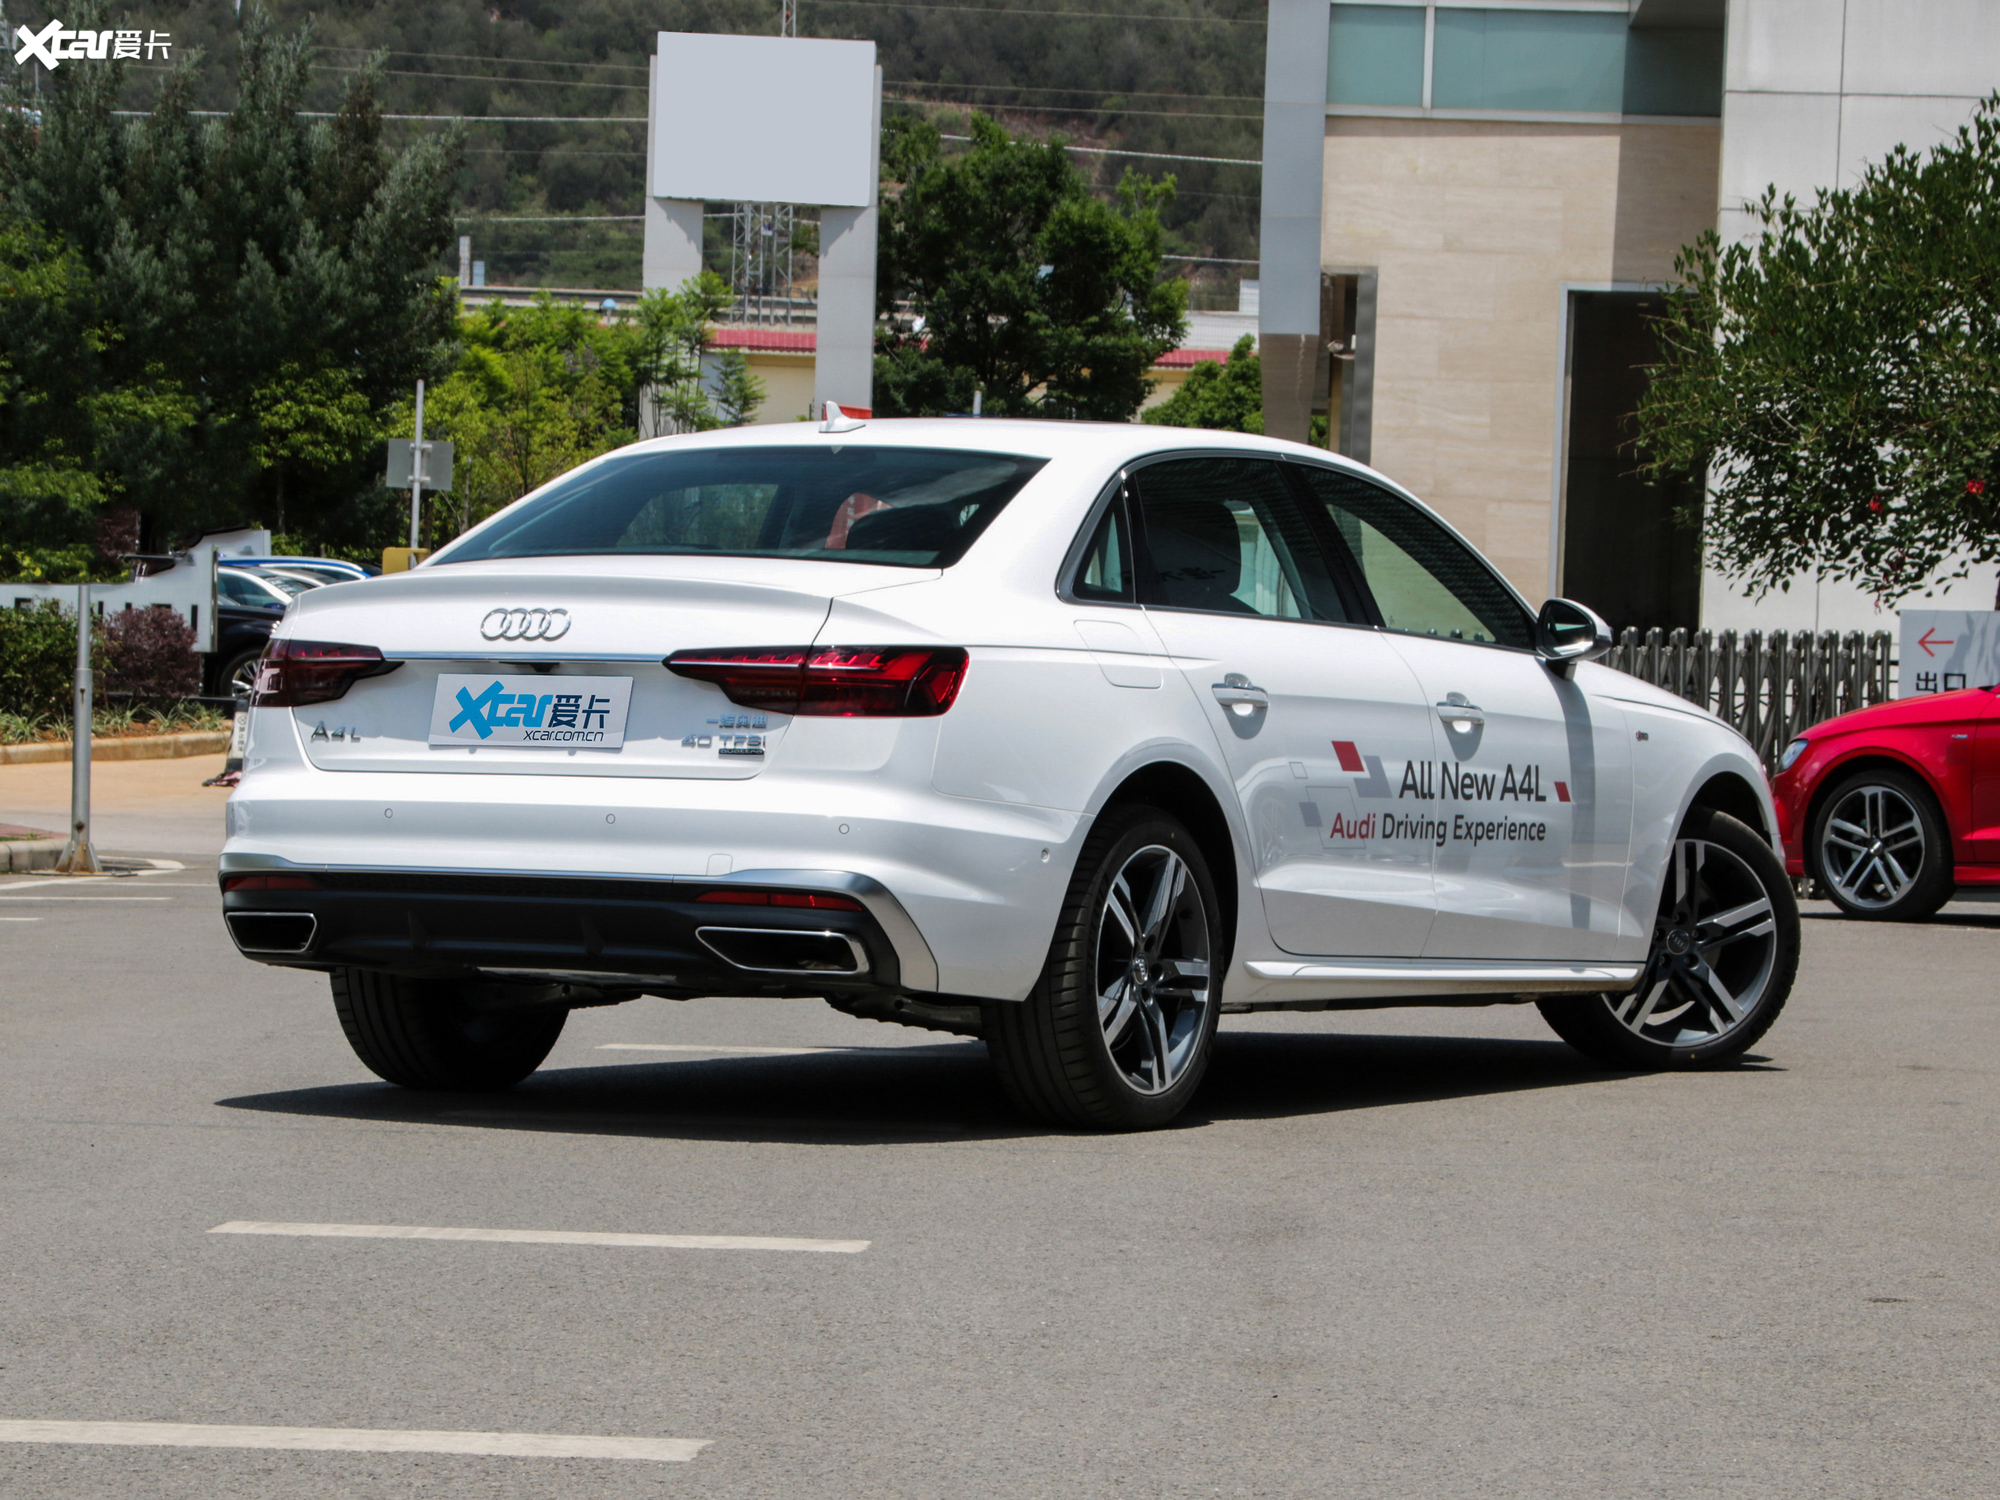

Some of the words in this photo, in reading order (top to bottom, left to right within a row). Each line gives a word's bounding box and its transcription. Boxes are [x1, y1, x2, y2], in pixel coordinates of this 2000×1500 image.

[1916, 671, 1967, 693] 出口
[523, 730, 604, 742] xcar.com.cn
[681, 734, 712, 748] 40
[719, 734, 767, 748] TFSI
[1398, 760, 1435, 800] All
[1440, 762, 1497, 800] New
[1499, 763, 1547, 802] A4L
[1329, 812, 1376, 839] Audi
[1382, 813, 1448, 847] Driving
[1453, 814, 1546, 847] Experience
